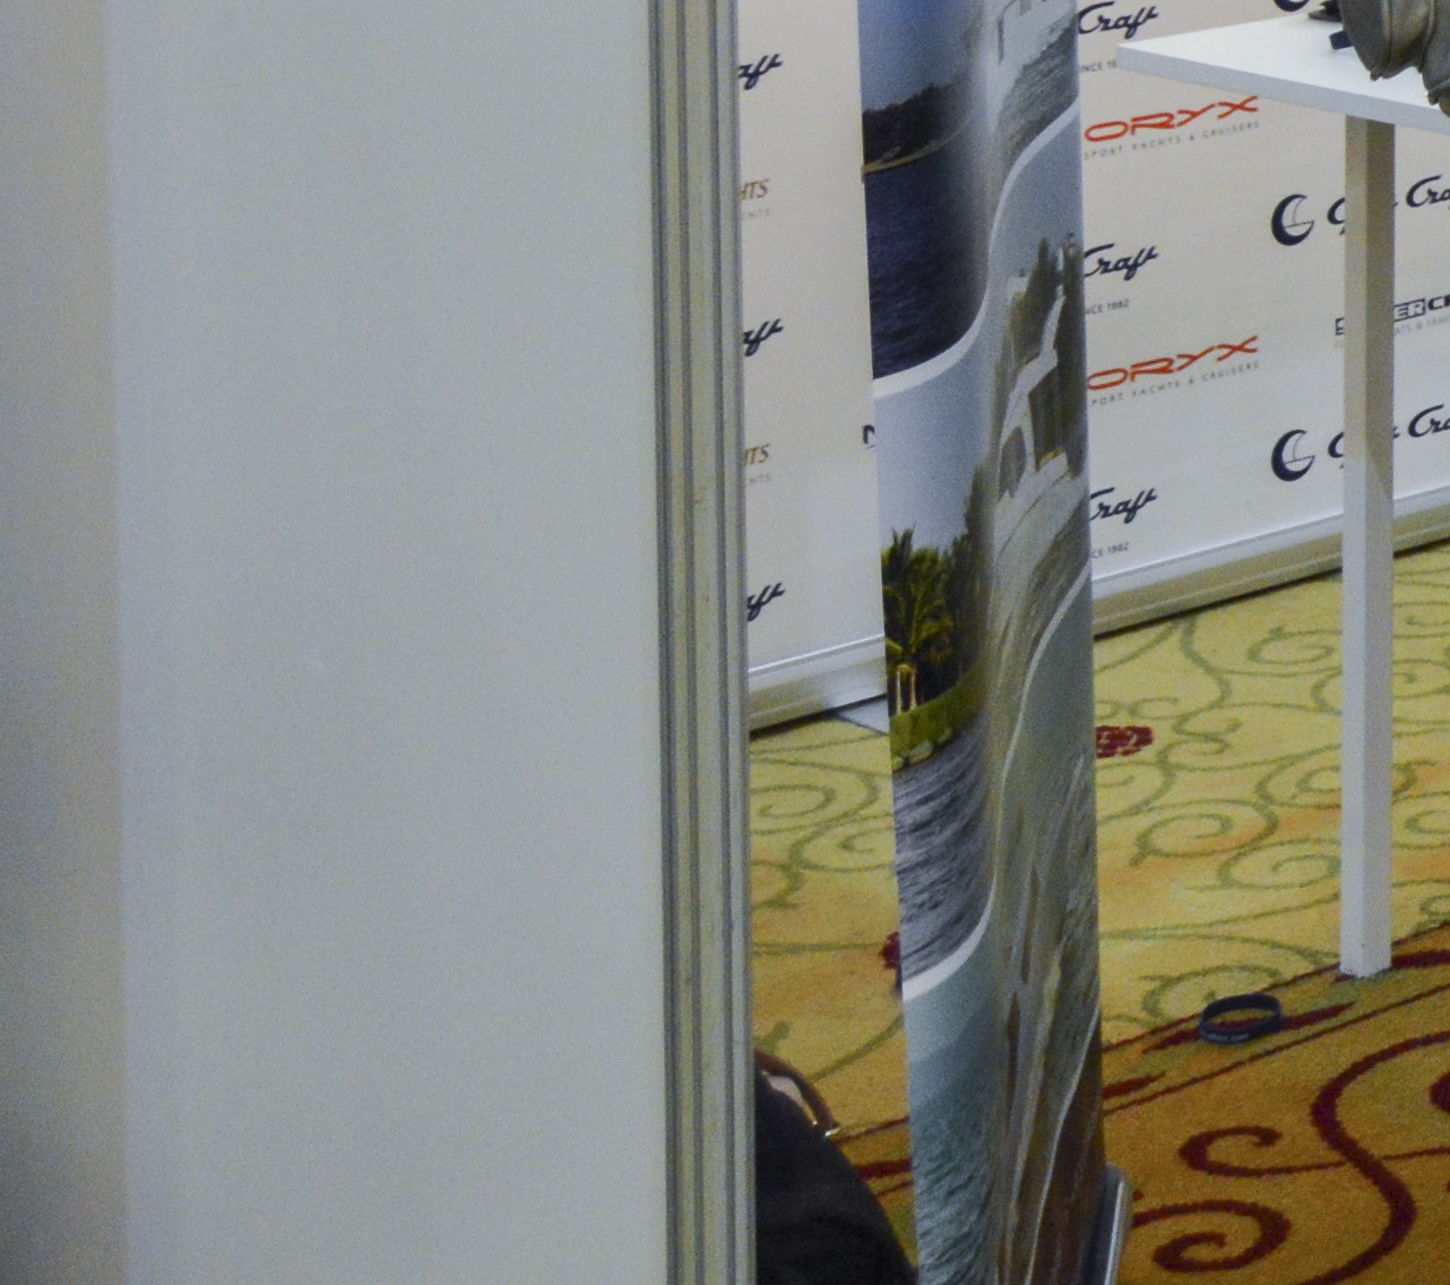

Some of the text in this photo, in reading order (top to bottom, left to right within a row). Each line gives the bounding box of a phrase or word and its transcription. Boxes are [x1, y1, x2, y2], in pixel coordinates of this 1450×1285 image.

[1078, 0, 1159, 39] Craft
[1085, 95, 1259, 142] ORYX
[1086, 334, 1259, 391] ORYX
